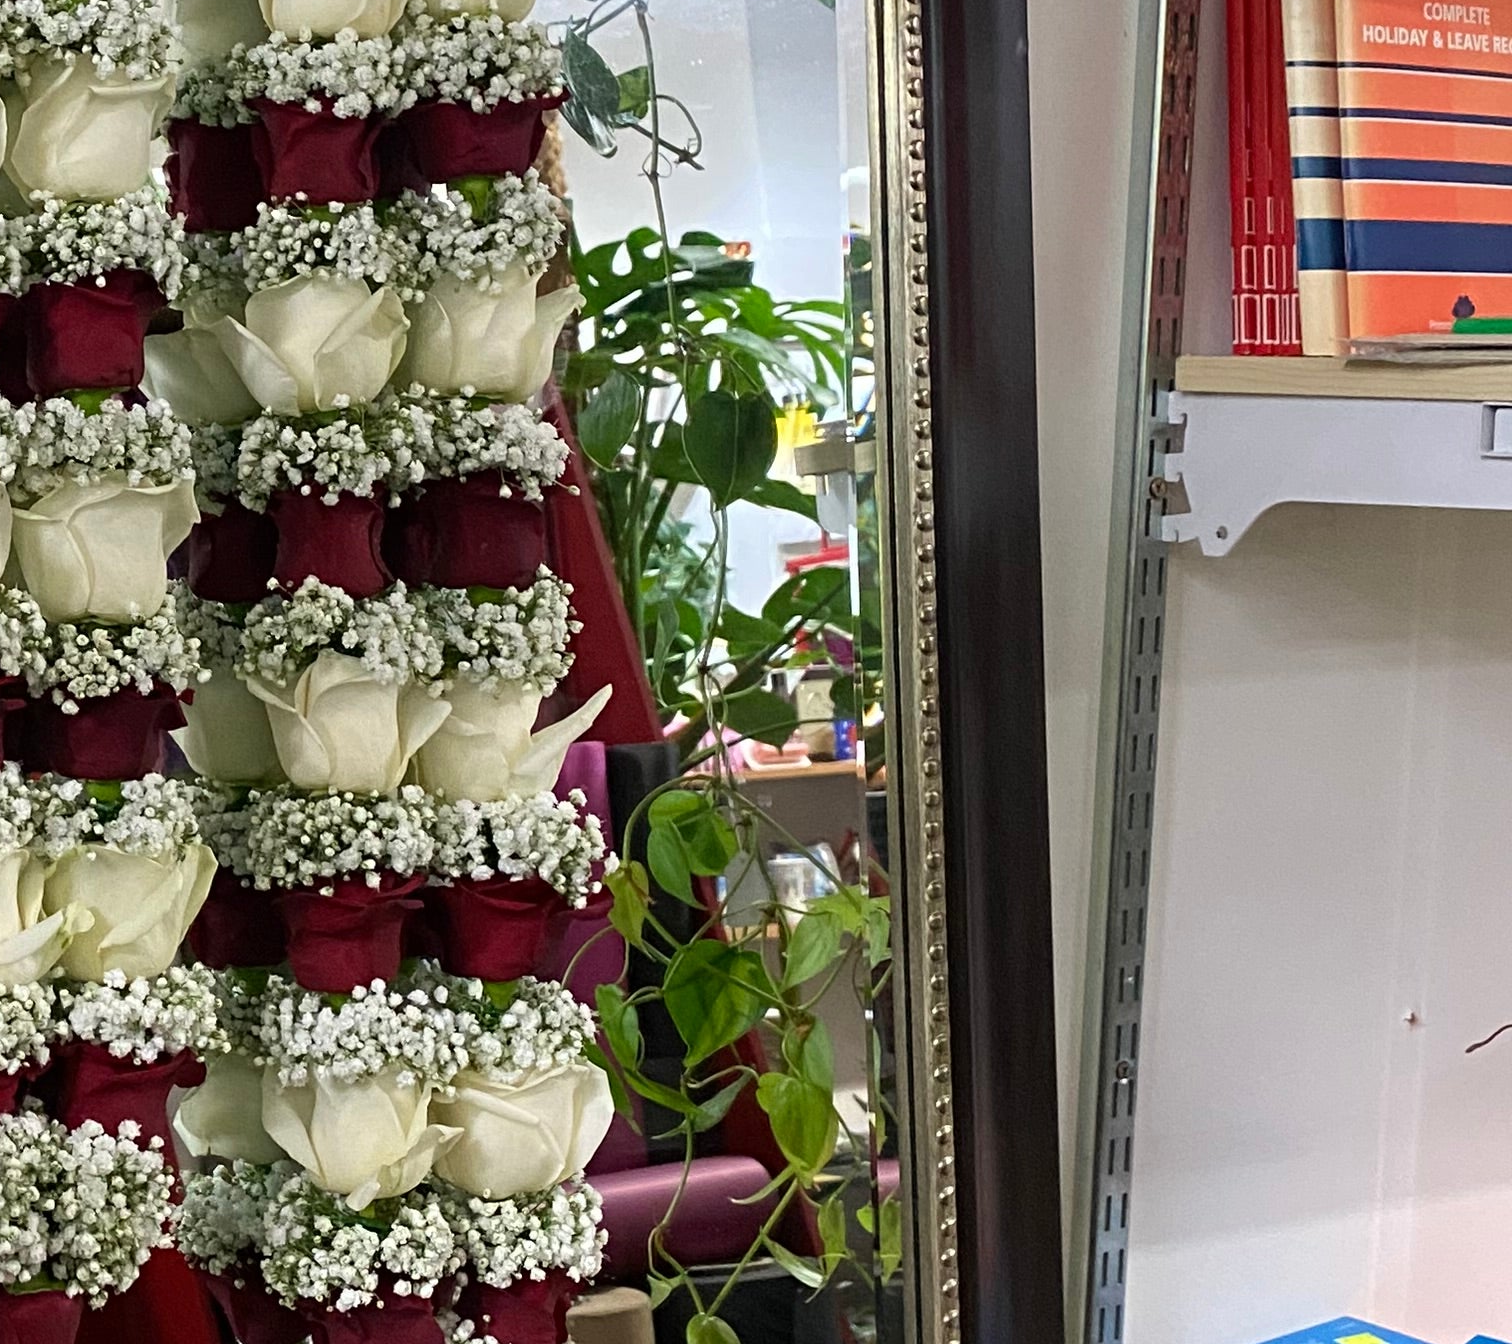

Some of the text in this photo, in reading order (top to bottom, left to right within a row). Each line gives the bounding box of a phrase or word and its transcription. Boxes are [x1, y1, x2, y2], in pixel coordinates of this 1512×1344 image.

[1423, 2, 1491, 26] COMPLETE
[1362, 24, 1428, 47] HOLIDAY
[1432, 30, 1443, 48] &
[1447, 31, 1490, 53] LEAVE
